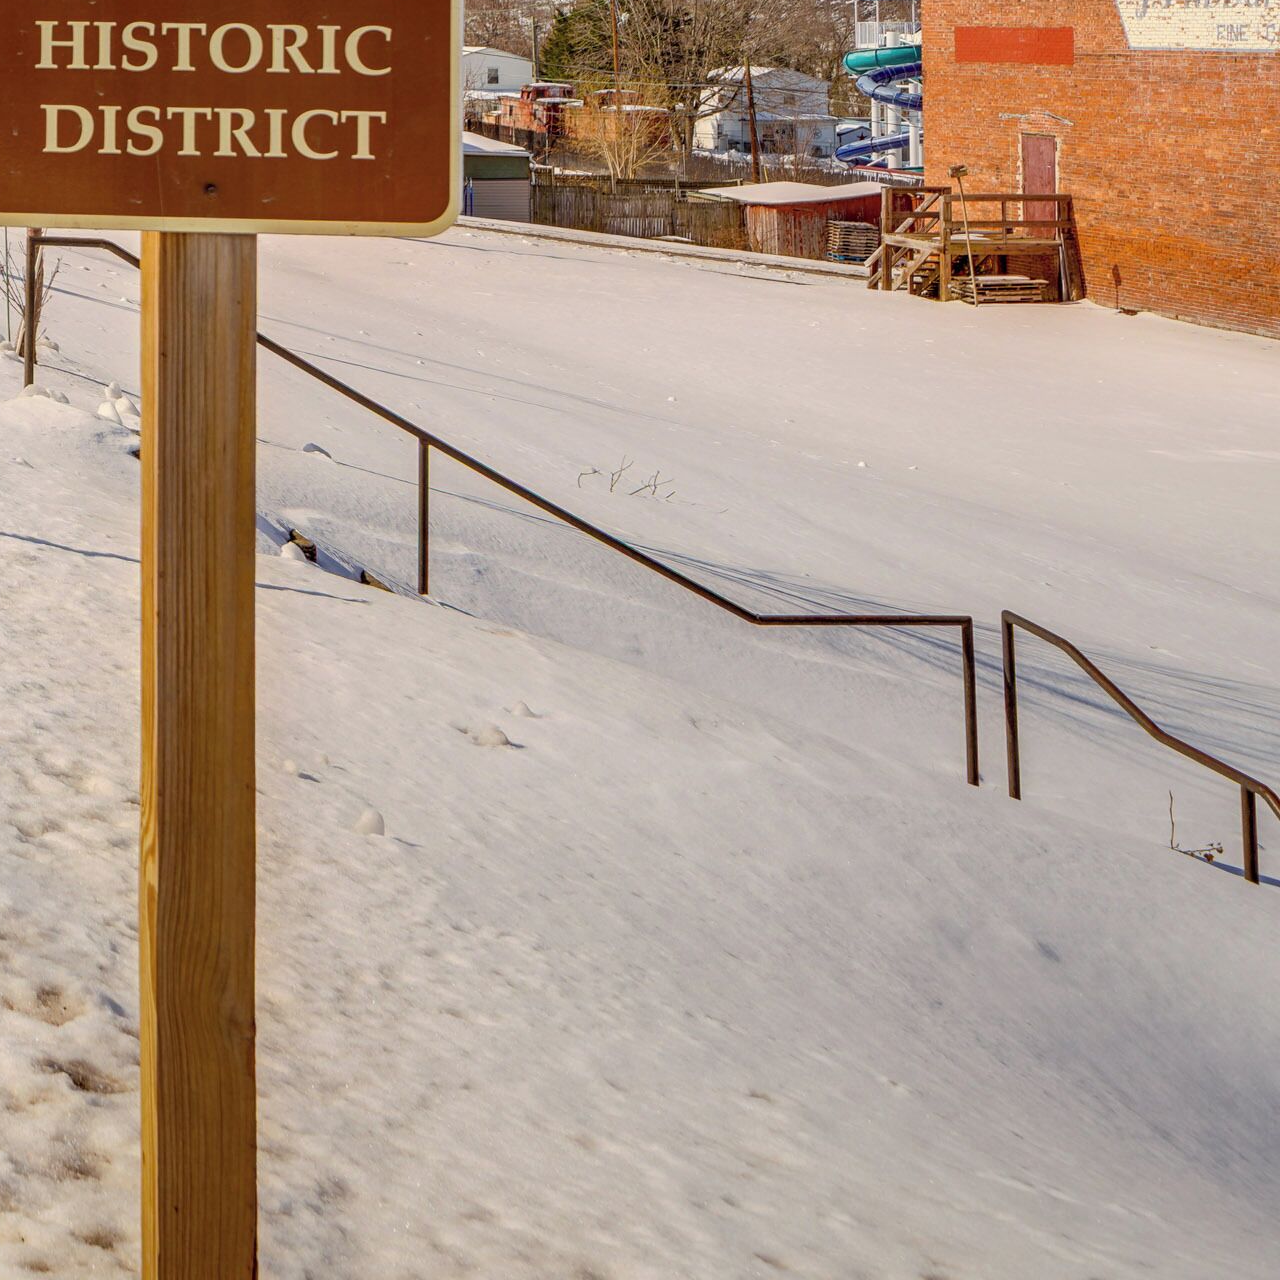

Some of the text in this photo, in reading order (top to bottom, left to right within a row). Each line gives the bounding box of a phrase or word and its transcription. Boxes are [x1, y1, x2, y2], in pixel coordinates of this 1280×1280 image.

[35, 20, 392, 75] HISTORIC
[1216, 23, 1248, 42] FINE
[40, 104, 387, 159] DISTRICT
